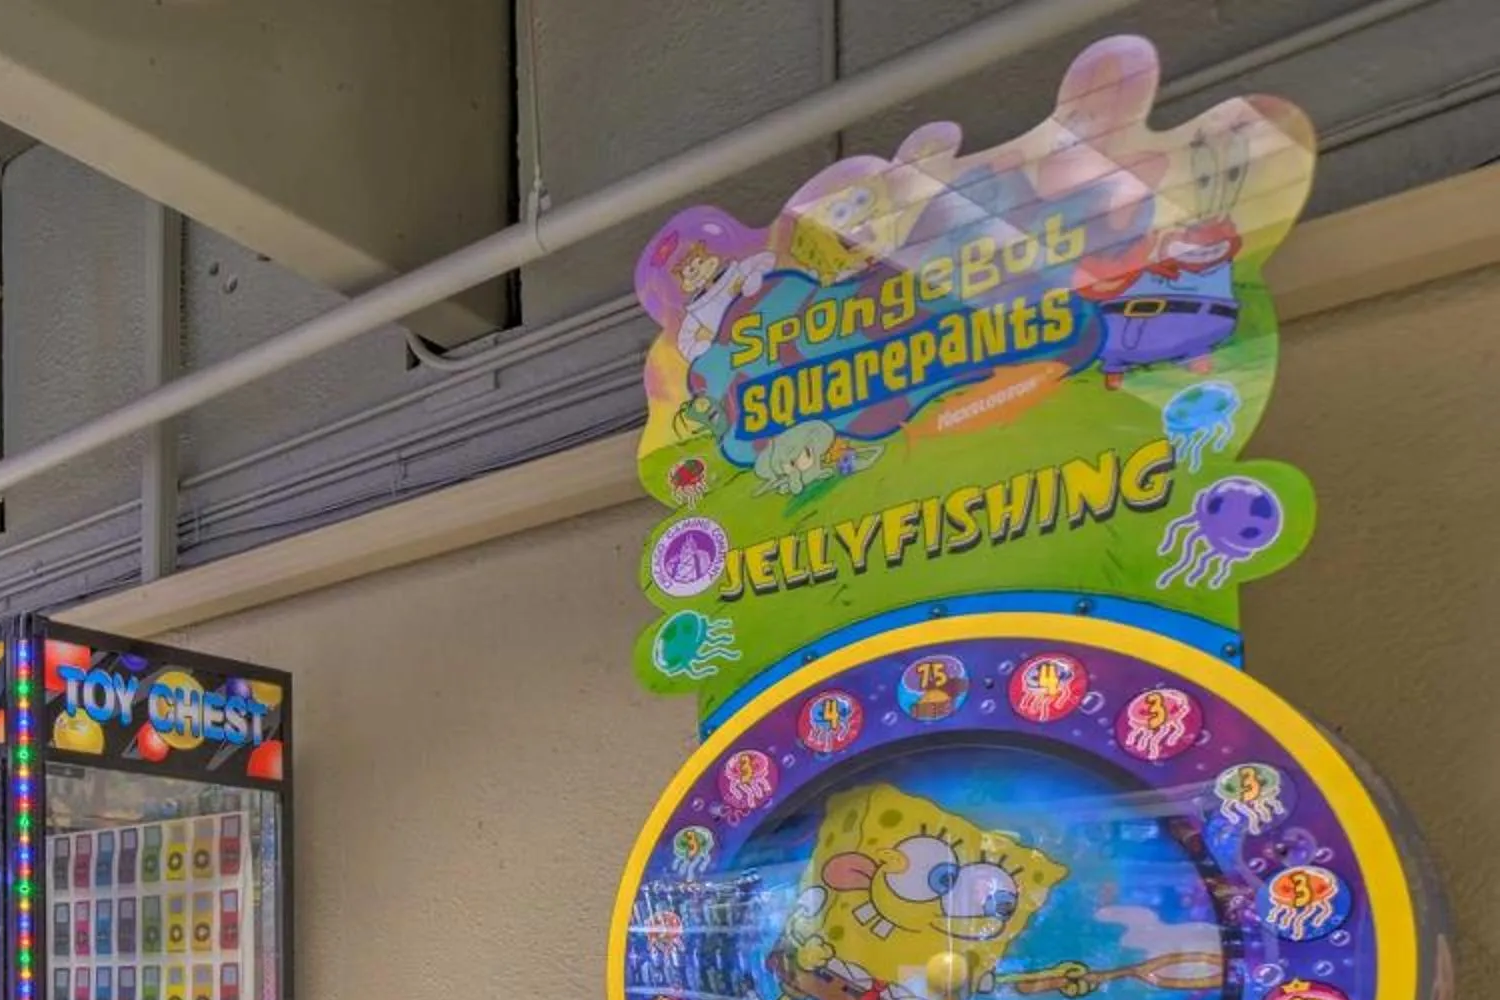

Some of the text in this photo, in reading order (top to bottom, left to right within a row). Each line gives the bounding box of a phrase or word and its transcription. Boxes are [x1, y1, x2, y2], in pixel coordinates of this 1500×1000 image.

[731, 213, 1087, 369] SpongeBob
[717, 439, 1175, 601] JELLYFISHING
[916, 662, 948, 689] 75
[1037, 663, 1060, 697] 4
[57, 664, 268, 746] TOY CHEST
[823, 698, 840, 729] 4
[1145, 691, 1167, 732] 3
[739, 754, 753, 785] 3
[1238, 766, 1261, 802] 3
[1292, 870, 1313, 909] 3
